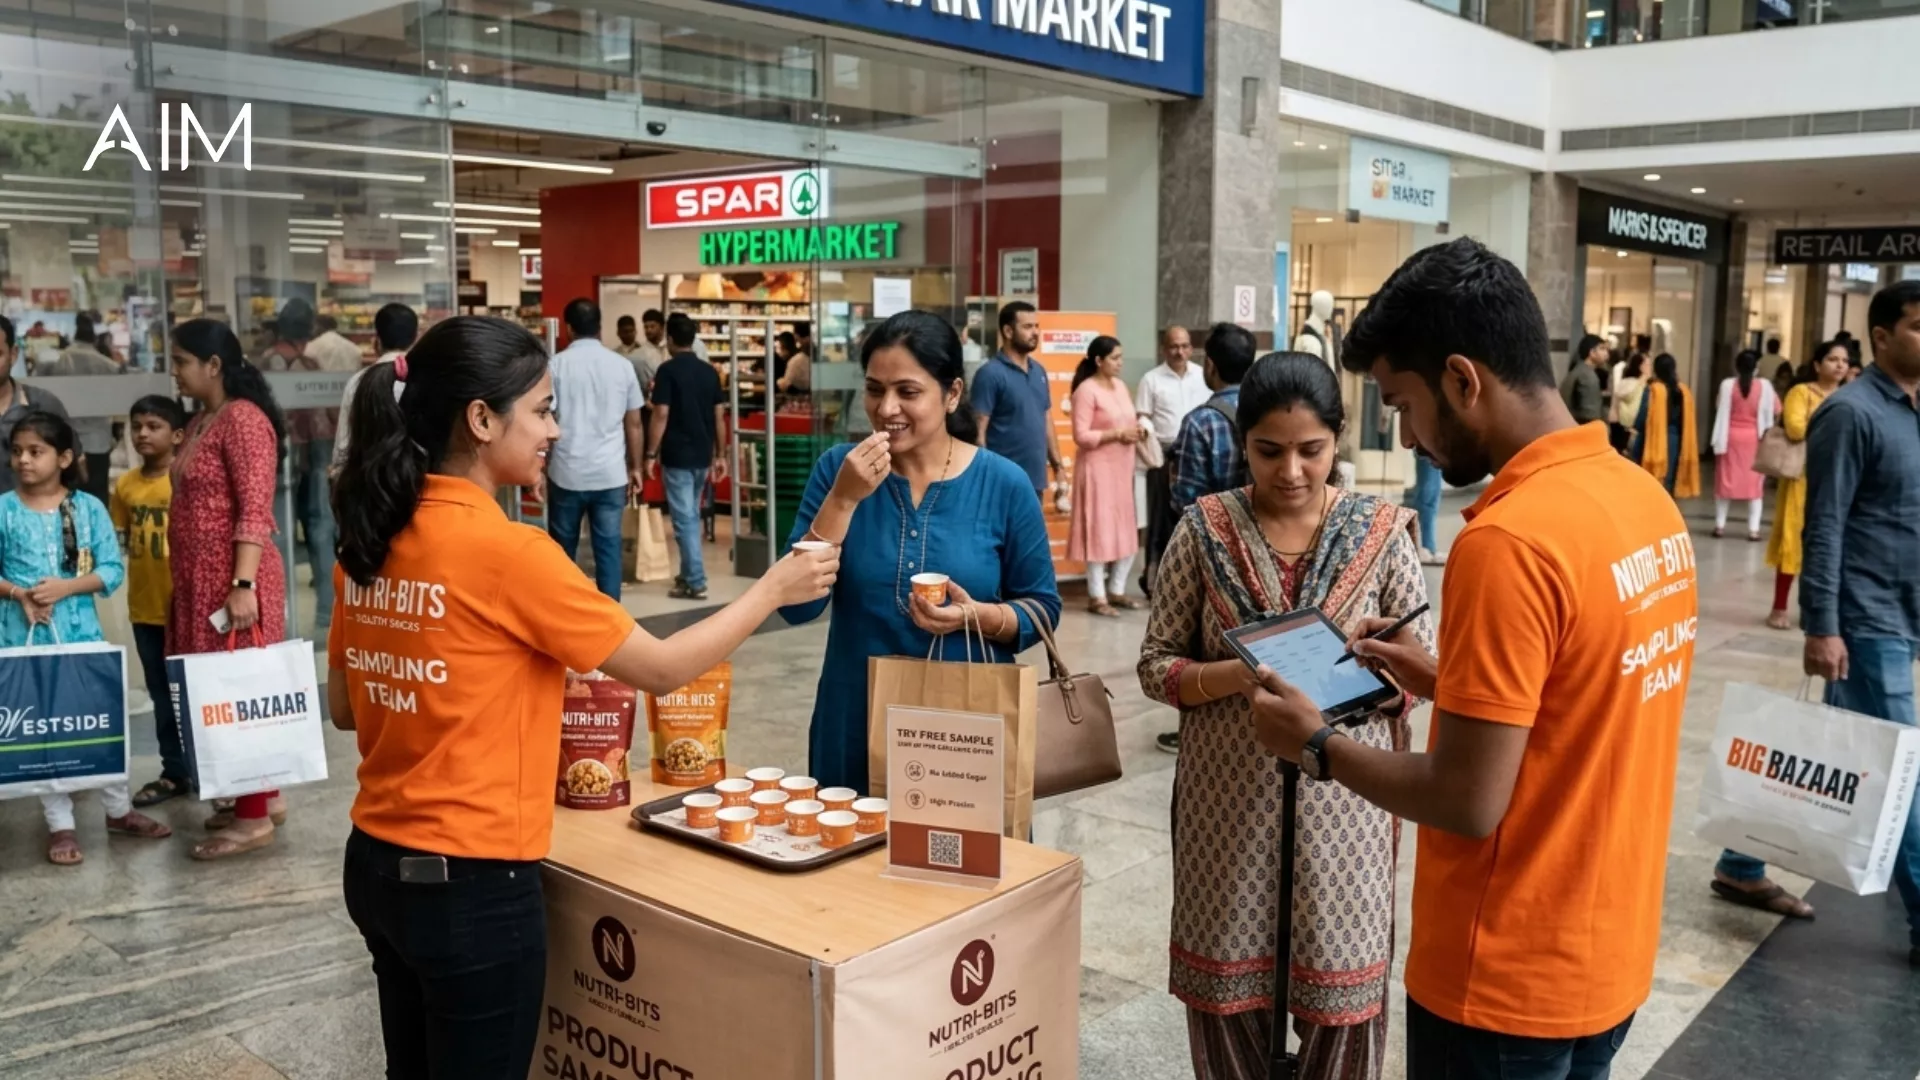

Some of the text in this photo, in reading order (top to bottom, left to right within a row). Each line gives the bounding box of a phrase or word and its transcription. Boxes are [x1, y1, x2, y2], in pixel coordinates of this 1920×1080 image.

[992, 0, 1171, 62] MARKET
[675, 181, 780, 217] SPAR
[699, 222, 899, 266] HYPERMARKET
[1781, 234, 1871, 257] RETAIL
[0, 705, 110, 742] WESTSIDE
[202, 702, 235, 728] BIG
[236, 691, 308, 723] BAZAAR
[896, 728, 917, 738] TRY
[919, 730, 947, 742] FREE
[949, 733, 994, 747] SAMPLE
[1727, 737, 1768, 776] BIG
[1765, 749, 1861, 805] BAZAAR
[573, 968, 661, 1022] NUTRI-BITS
[928, 989, 1017, 1049] NUTRI-BITS
[547, 1005, 694, 1080] PRODUCT
